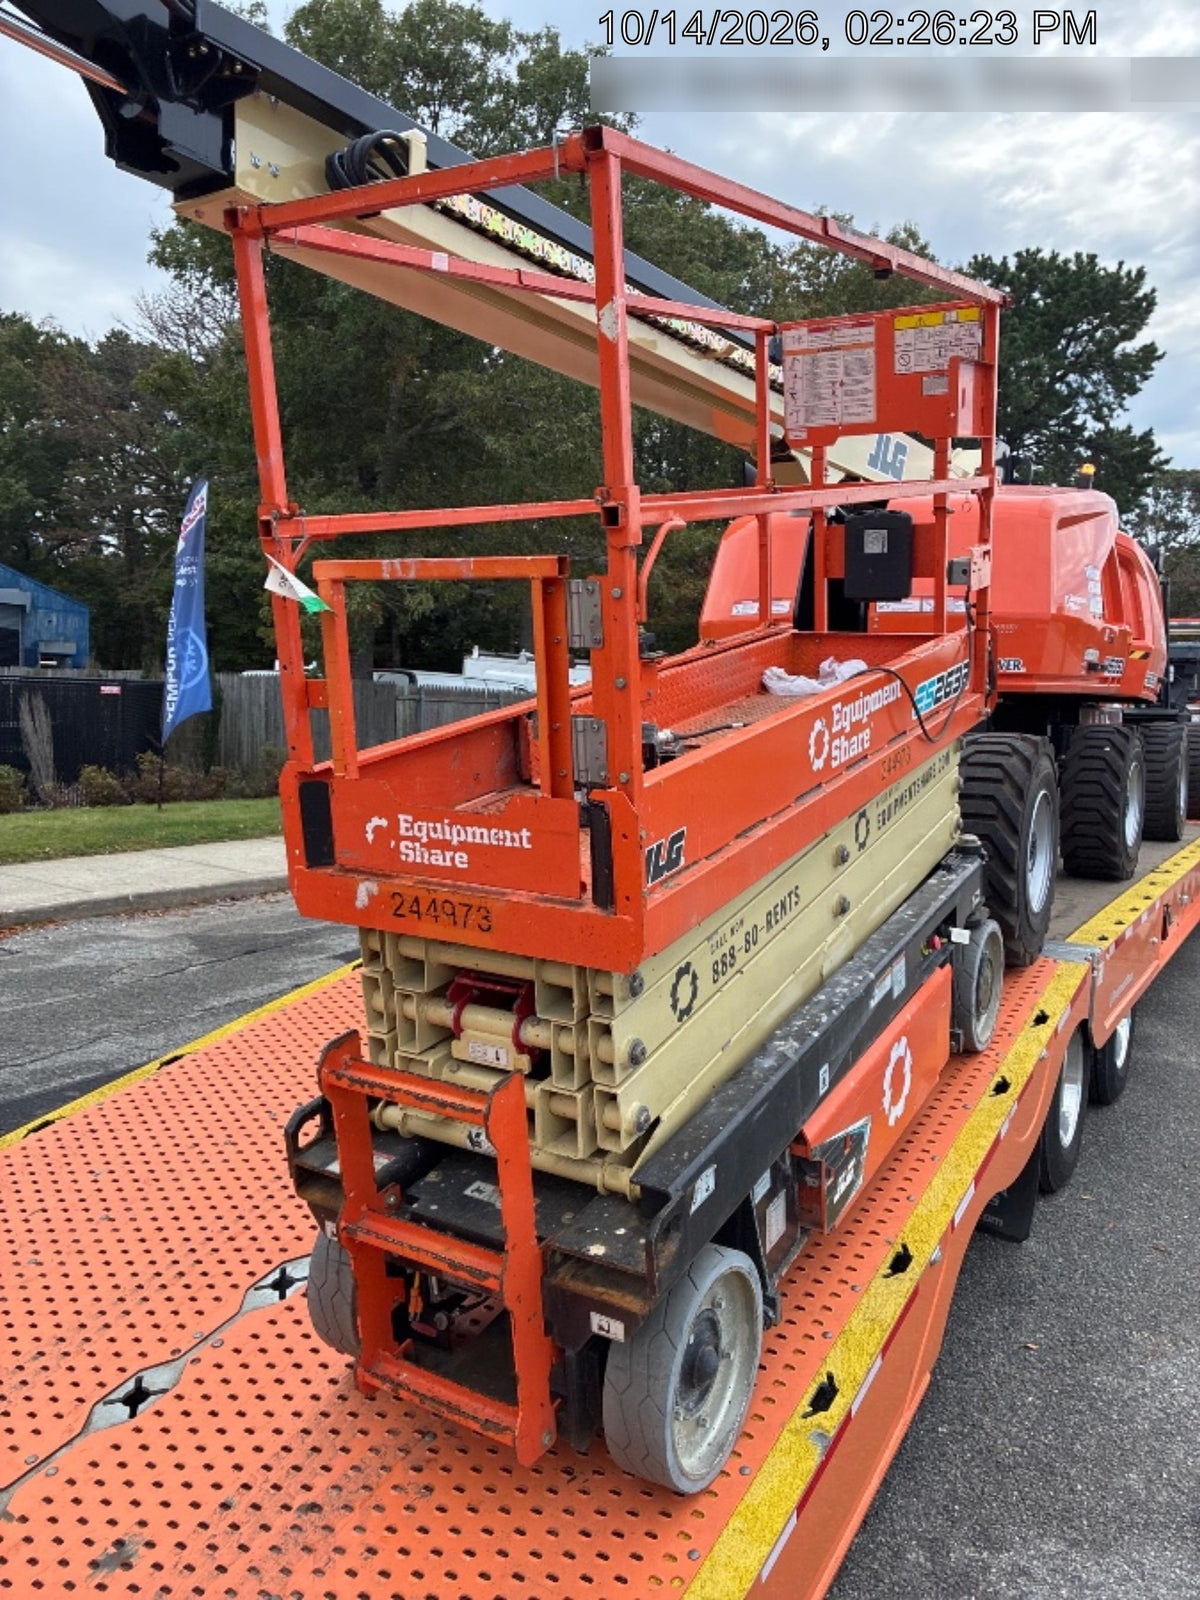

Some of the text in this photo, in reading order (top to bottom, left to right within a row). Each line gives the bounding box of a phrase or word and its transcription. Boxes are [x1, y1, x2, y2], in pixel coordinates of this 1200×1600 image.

[867, 434, 908, 481] JLG
[831, 679, 902, 733] Equipment
[831, 728, 871, 768] Share
[398, 814, 532, 849] Equipment
[399, 841, 469, 869] Share
[391, 892, 493, 933] 244973
[712, 885, 801, 984] 888-80-RENTS
